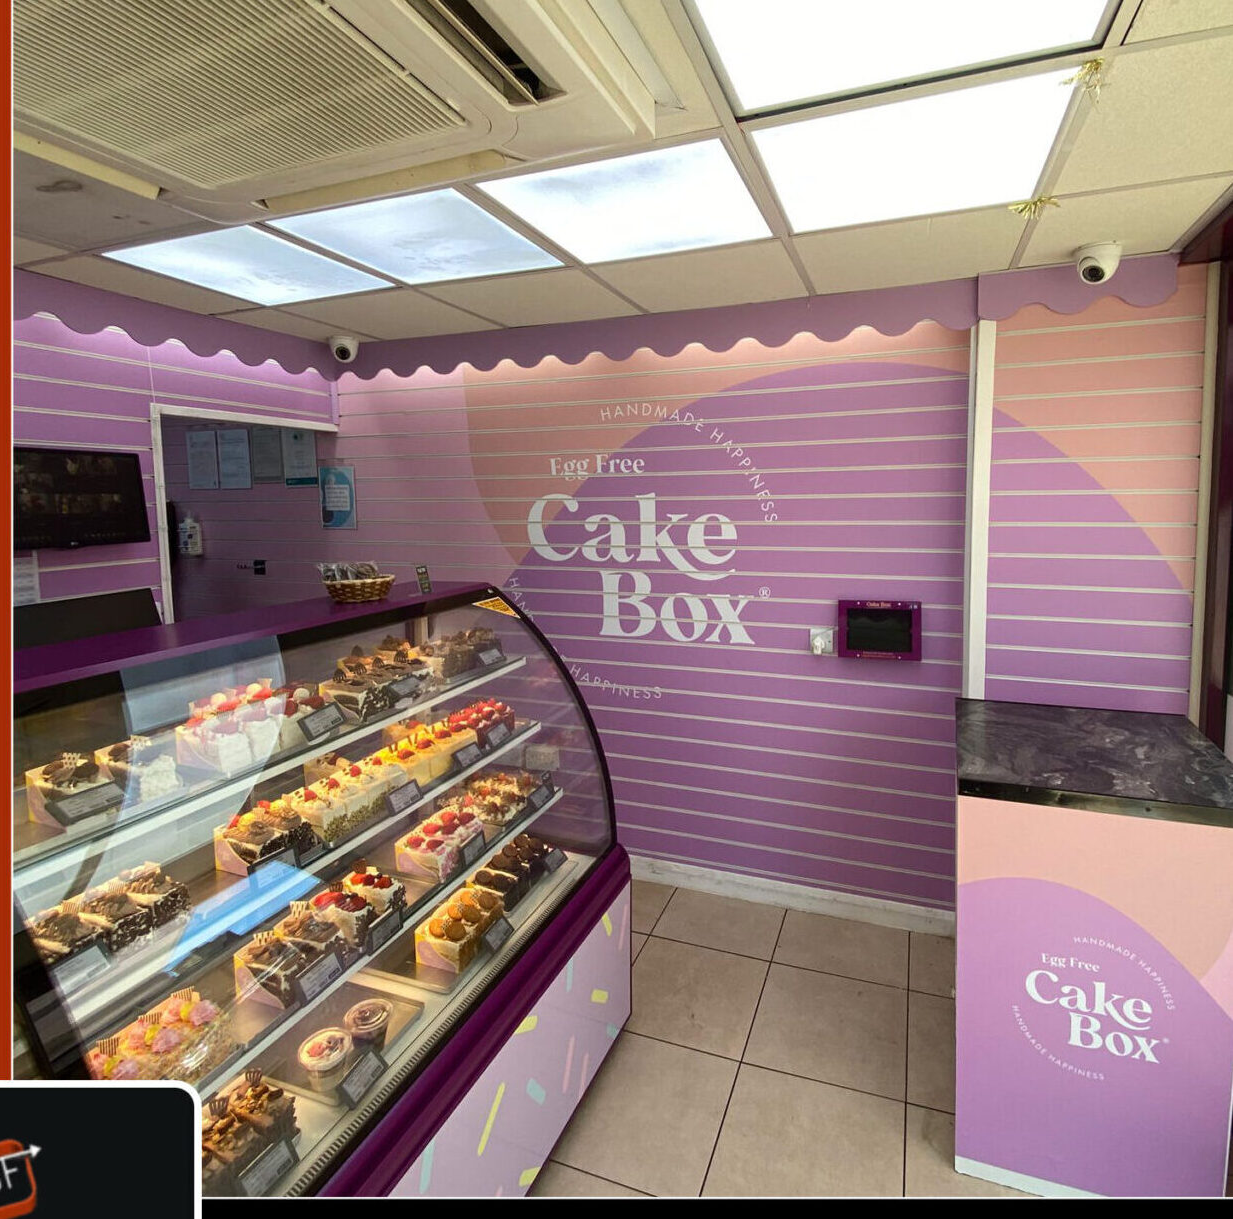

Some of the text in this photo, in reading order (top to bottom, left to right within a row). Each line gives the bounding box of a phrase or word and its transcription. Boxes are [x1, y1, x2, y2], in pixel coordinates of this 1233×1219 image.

[600, 402, 704, 433] HANDMADE
[549, 454, 645, 481] Egg Free
[527, 492, 738, 581] Cake
[571, 665, 662, 699] HAPPINESS
[1042, 953, 1100, 973] Egg Free
[1073, 936, 1175, 1011] HANDMADE HAPPINESS
[1026, 970, 1152, 1031] Cake
[1012, 1004, 1105, 1080] HANDMADE HAPPINESS
